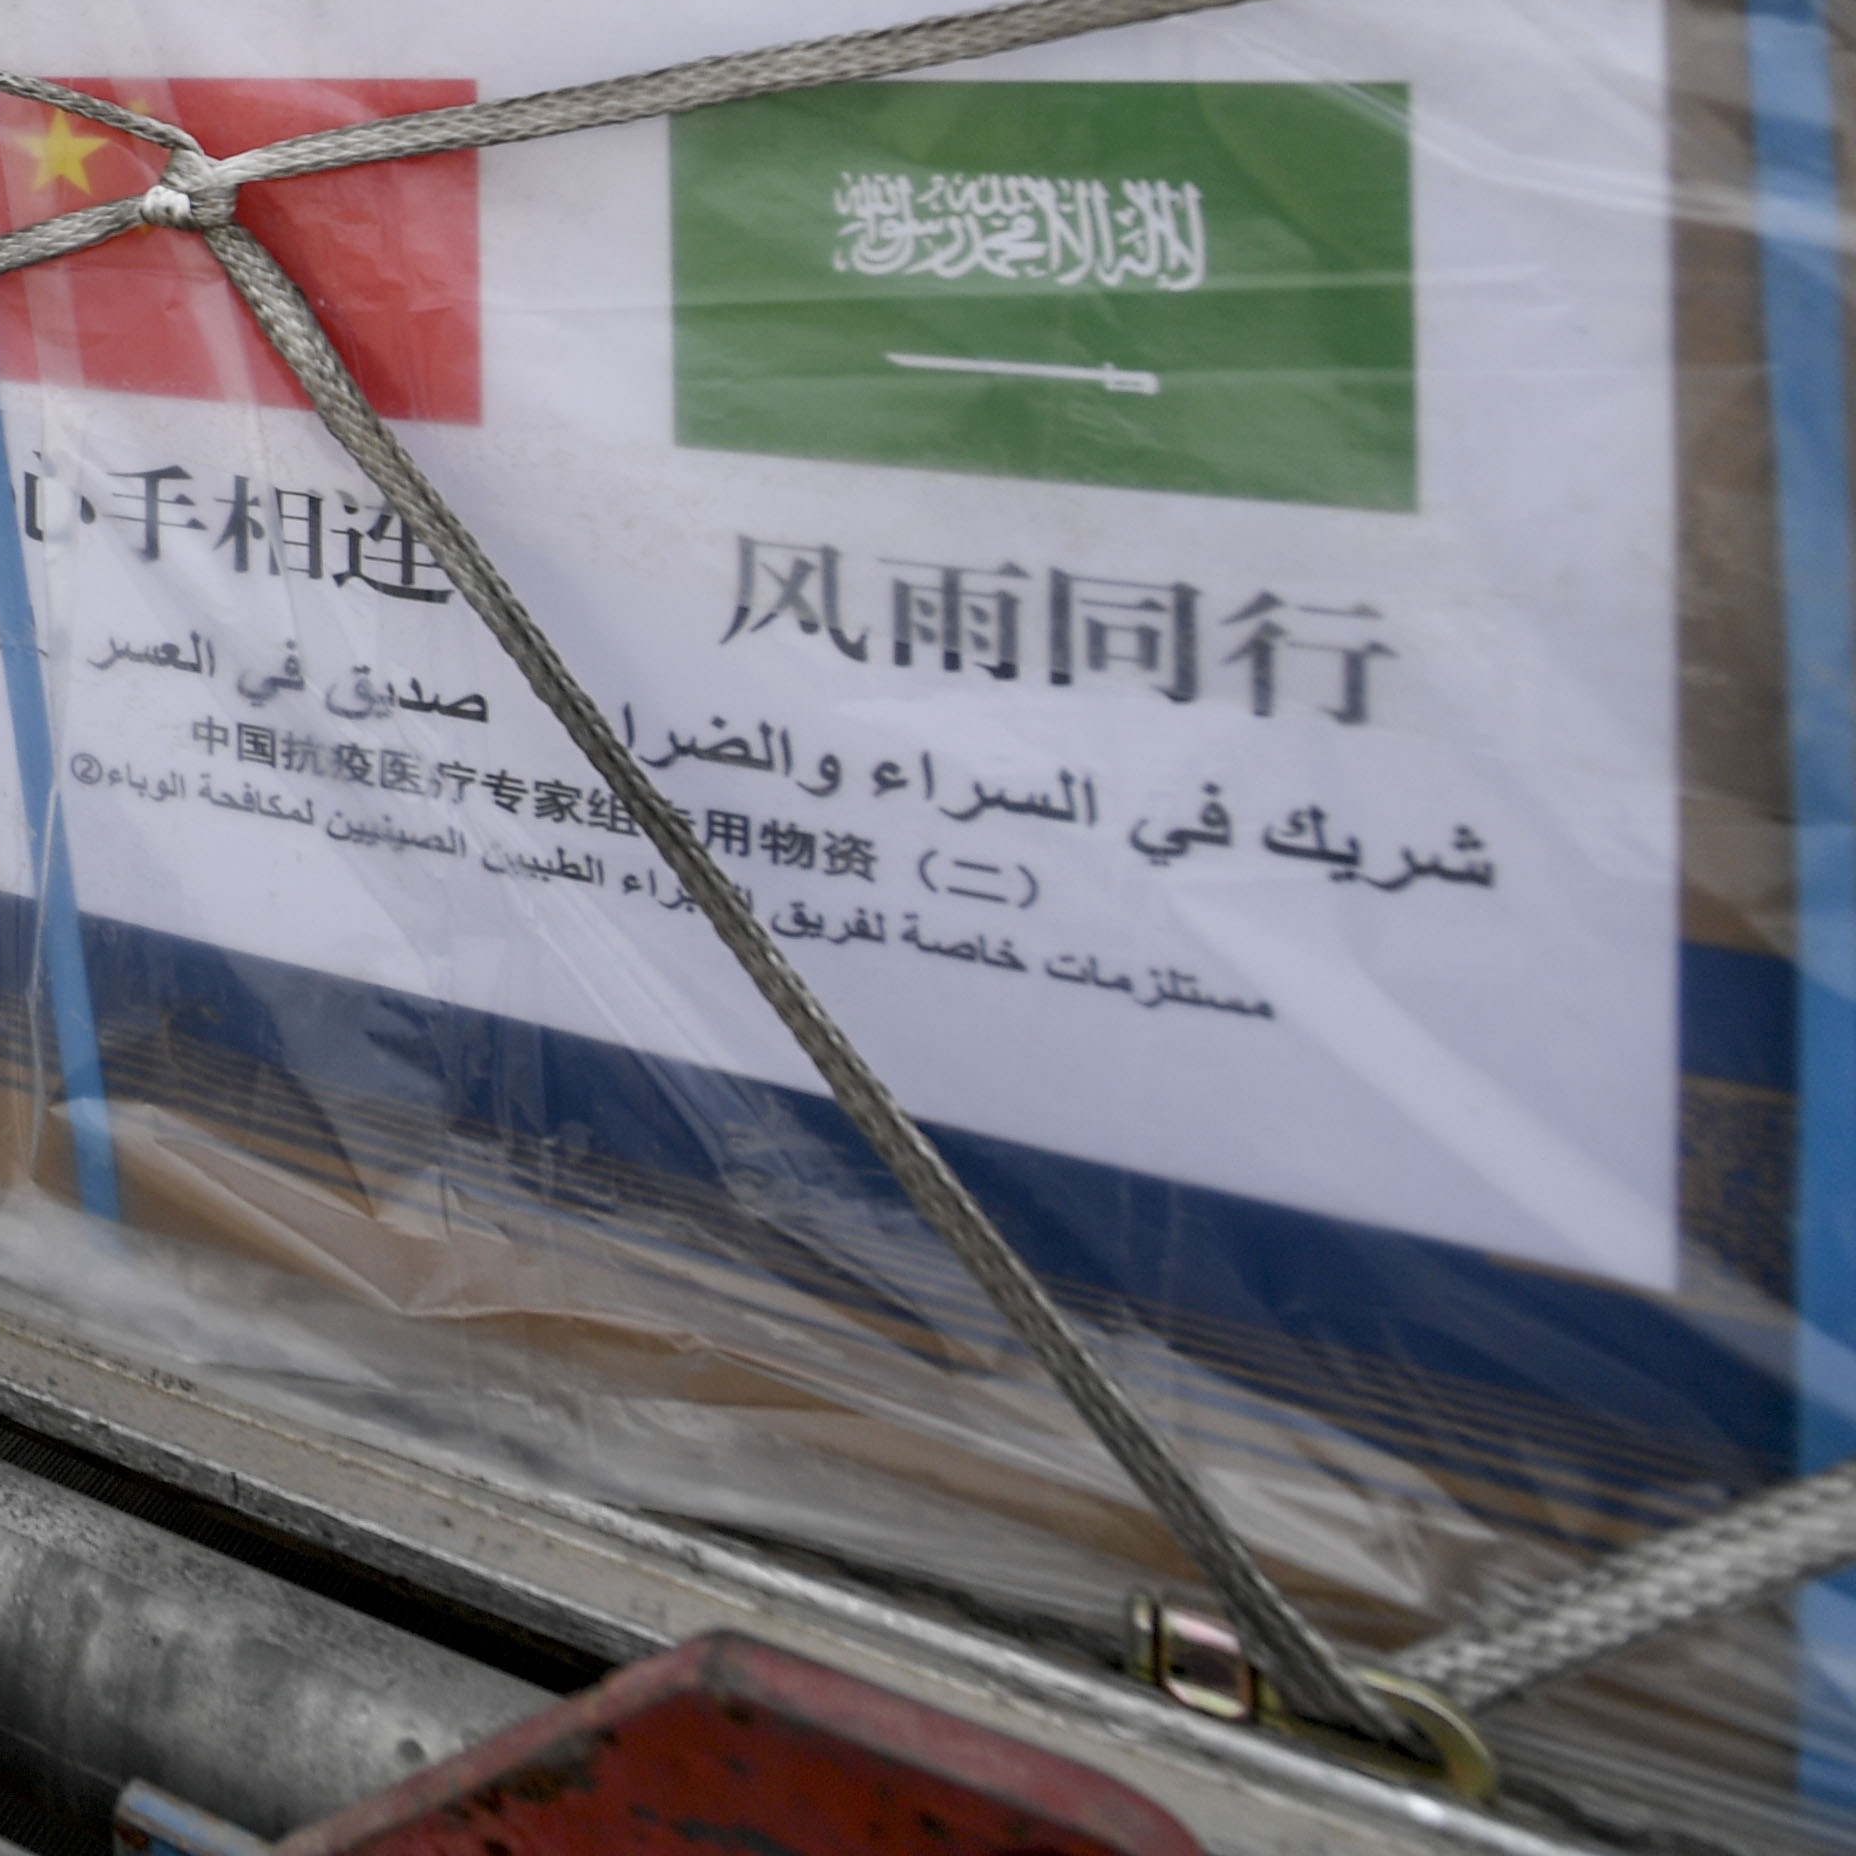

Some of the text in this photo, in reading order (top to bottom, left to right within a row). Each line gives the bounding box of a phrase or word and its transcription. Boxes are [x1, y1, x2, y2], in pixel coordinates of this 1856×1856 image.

[88, 630, 215, 677] العسر
[720, 533, 1401, 726] 风雨同行
[236, 638, 306, 707] في
[324, 662, 489, 722] صديق
[622, 702, 1495, 893] شريك في السراء والضرا
[899, 912, 1028, 973] خاصة
[1044, 953, 1276, 1020] مستلزمات
